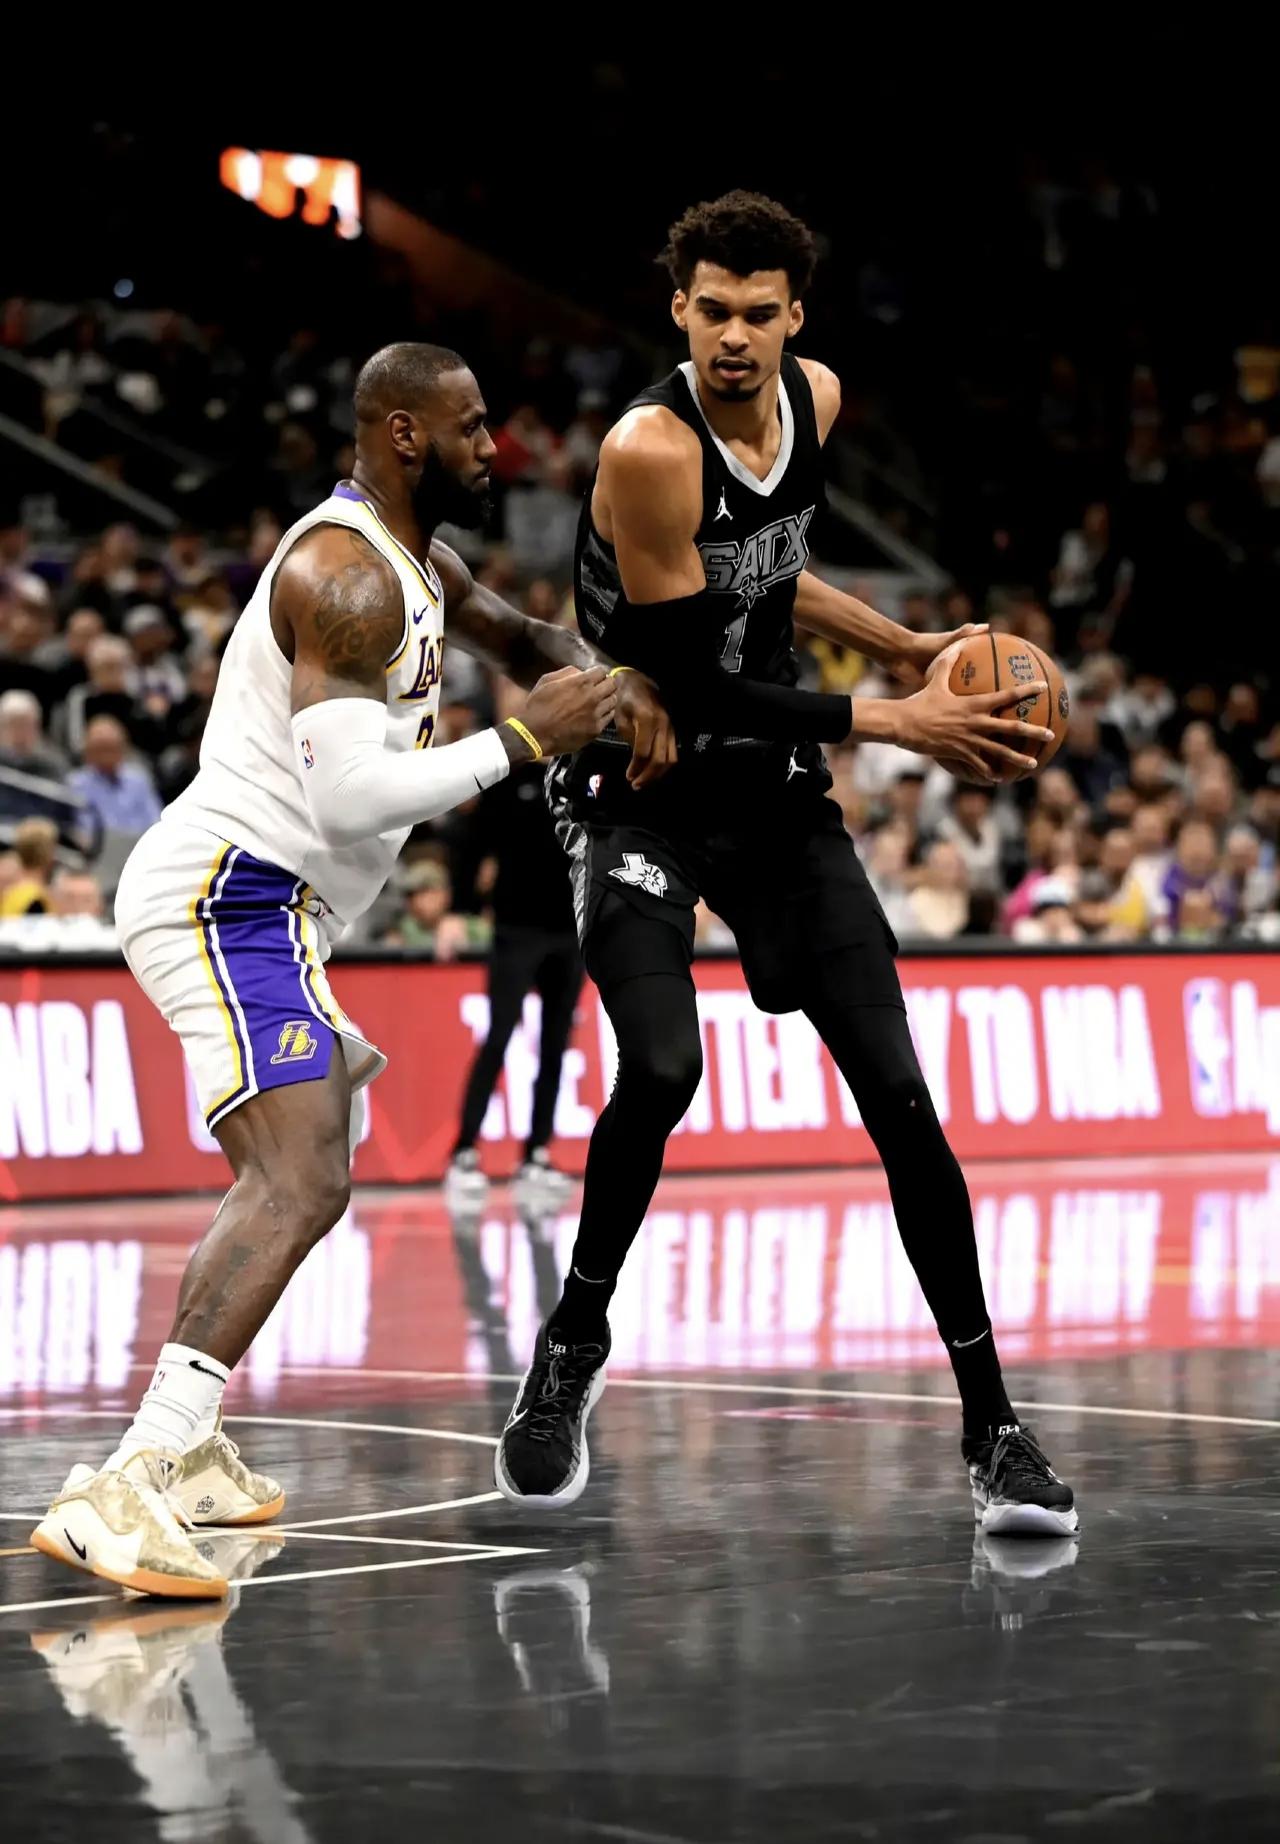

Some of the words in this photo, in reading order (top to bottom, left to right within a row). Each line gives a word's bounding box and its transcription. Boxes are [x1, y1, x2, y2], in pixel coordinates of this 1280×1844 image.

[699, 504, 816, 595] SATX
[719, 612, 748, 673] 1
[0, 1000, 145, 1159] NBA
[1041, 984, 1163, 1121] NBA
